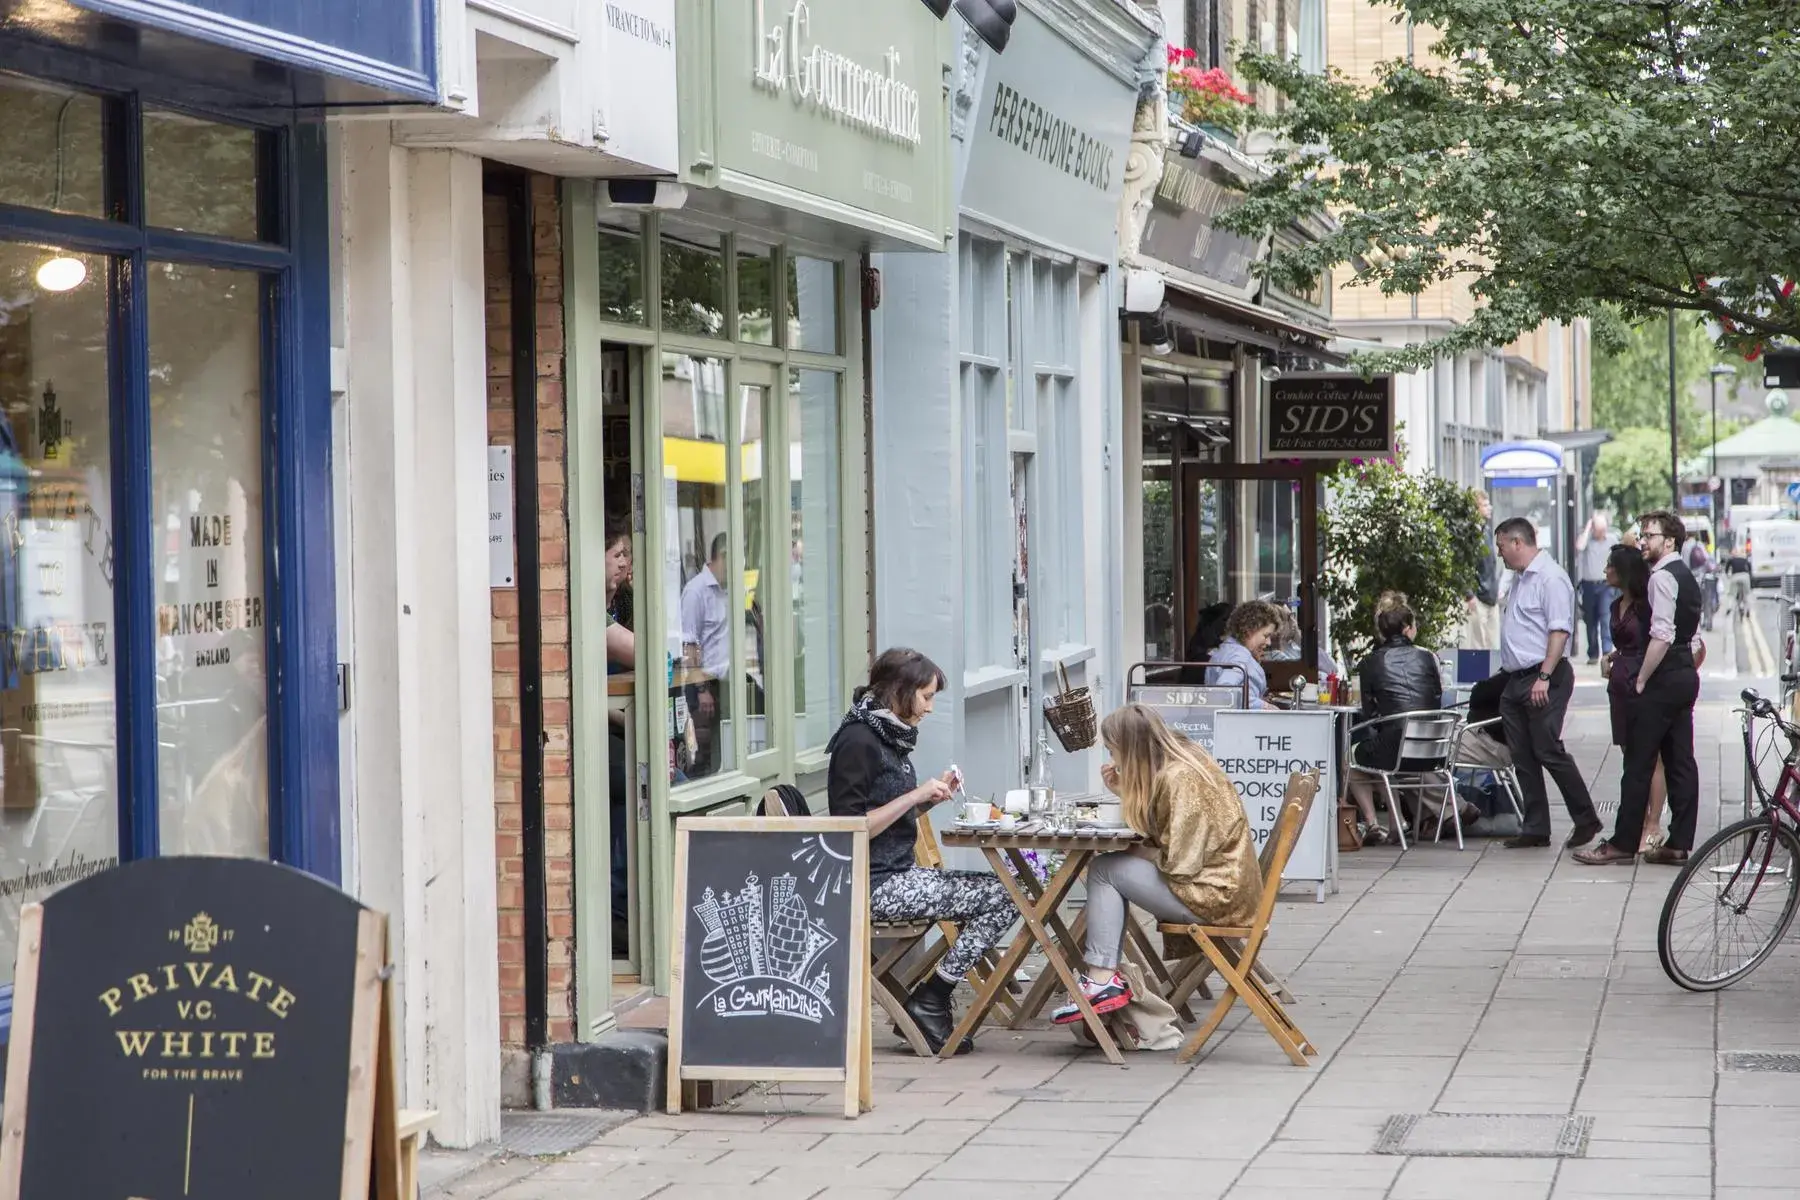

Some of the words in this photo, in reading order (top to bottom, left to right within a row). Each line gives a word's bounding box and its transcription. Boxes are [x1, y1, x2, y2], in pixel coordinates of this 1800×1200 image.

[756, 0, 786, 90] La
[792, 0, 921, 144] Gourmandina
[989, 81, 1077, 174] PERSEPHONE
[1074, 132, 1114, 192] BOOKS
[1280, 404, 1379, 434] SID'S
[488, 468, 505, 482] ies
[190, 515, 232, 547] MADE
[206, 559, 218, 584] IN
[159, 597, 262, 638] MANCHESTER
[196, 648, 230, 667] ENGLAND
[1166, 691, 1208, 705] SID'S
[1255, 736, 1291, 751] THE
[1217, 758, 1327, 775] PERSEPHONE
[1261, 806, 1275, 821] IS
[168, 929, 180, 942] 19
[222, 929, 235, 942] 17
[99, 962, 297, 1019] PRIVATE
[115, 1031, 276, 1058] WHITE
[142, 1068, 168, 1080] FOR
[174, 1068, 197, 1080] THE
[202, 1069, 243, 1081] BRAVE
